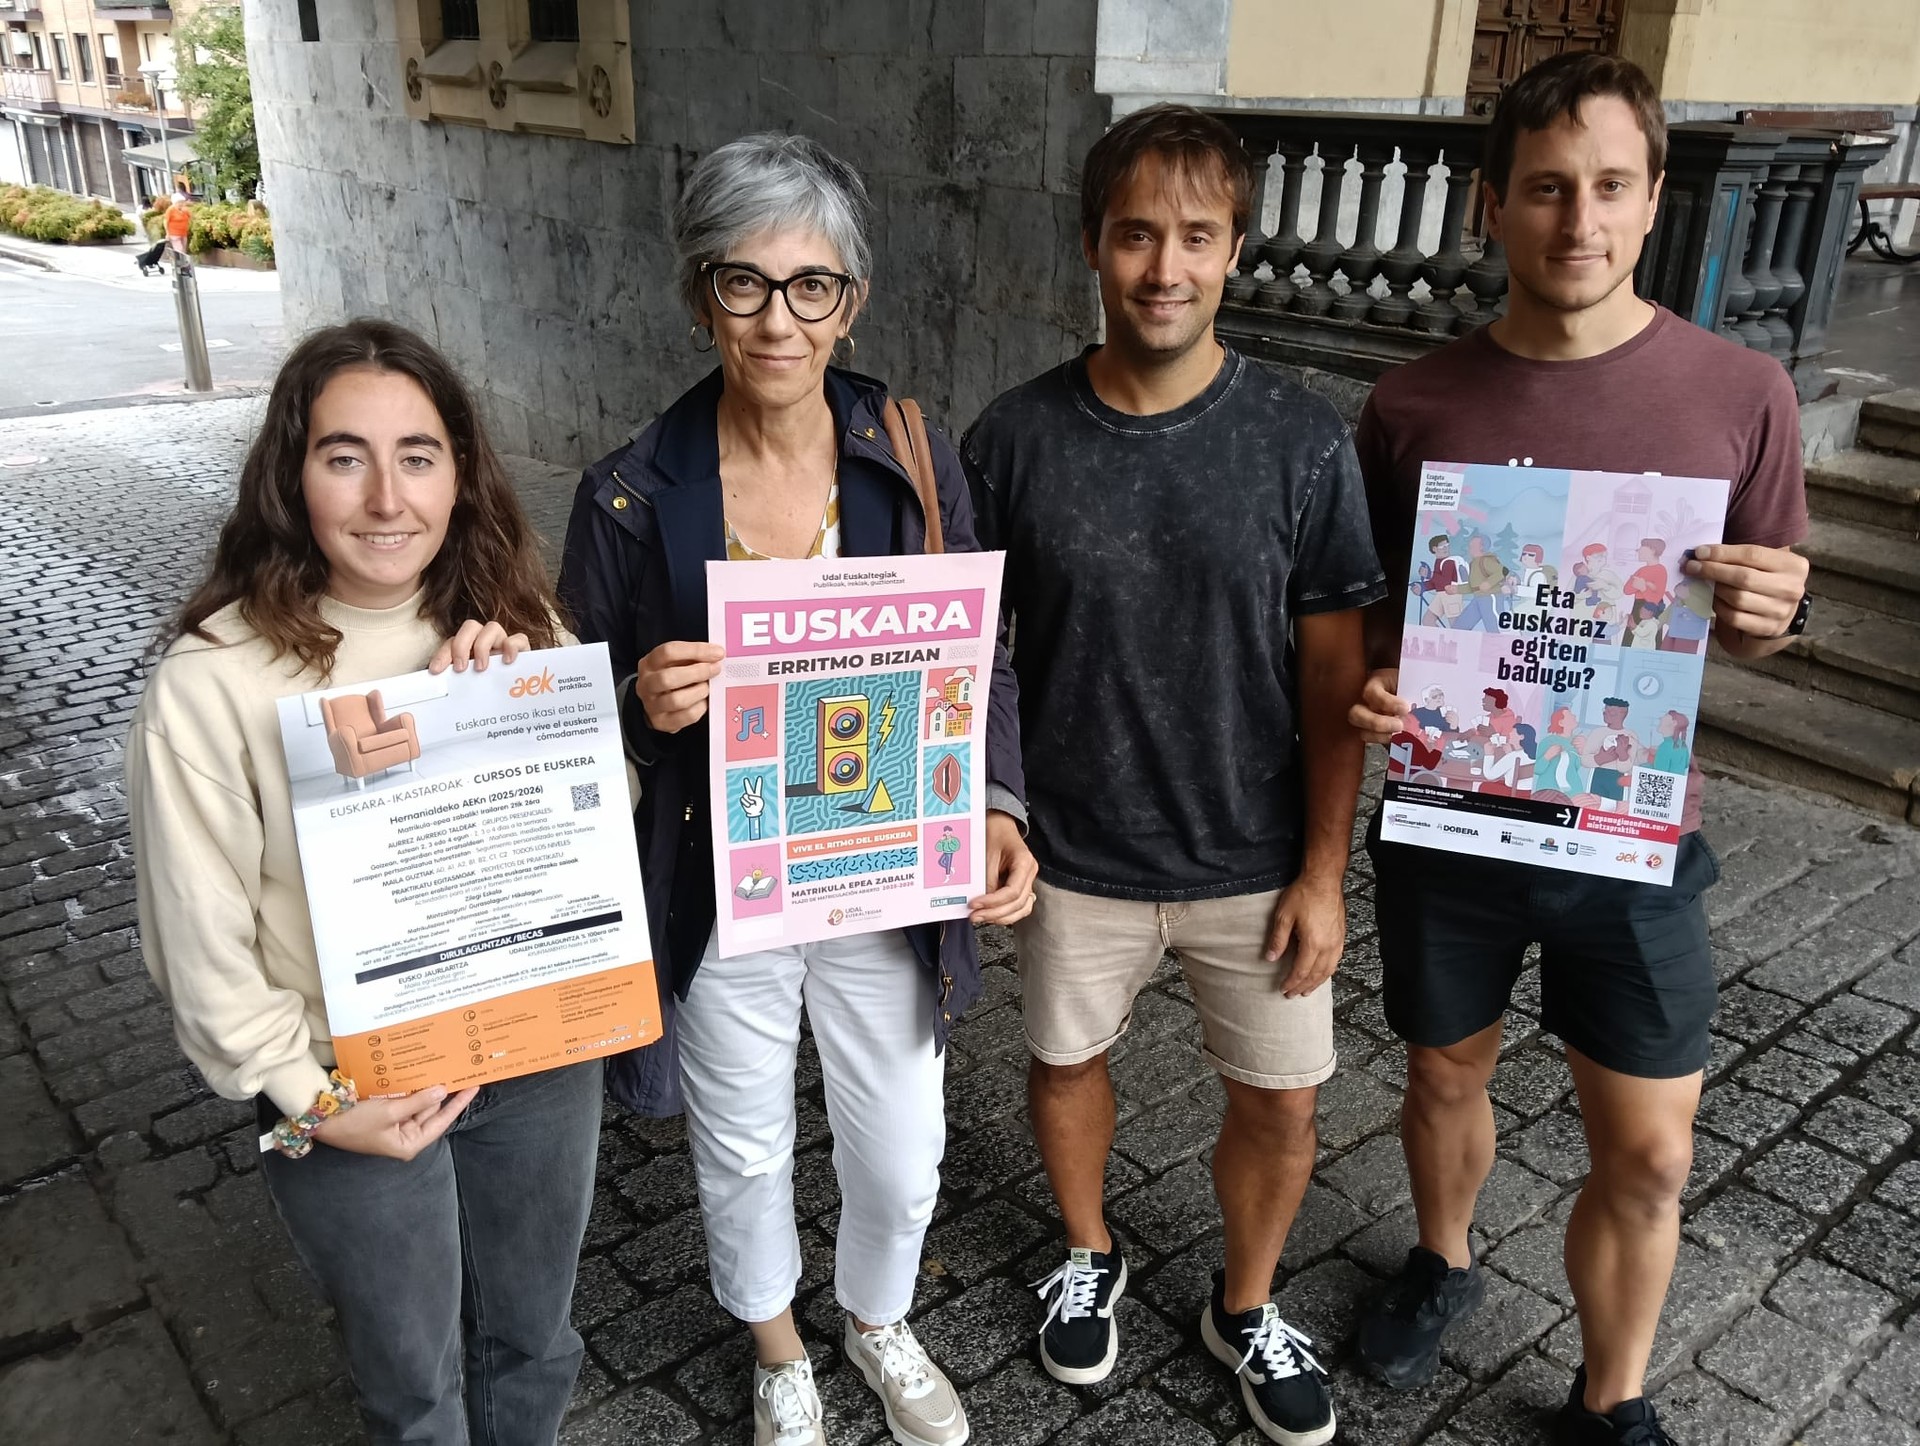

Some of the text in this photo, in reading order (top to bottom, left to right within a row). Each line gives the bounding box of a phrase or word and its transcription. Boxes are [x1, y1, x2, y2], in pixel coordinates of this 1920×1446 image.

[843, 571, 897, 580] Euskaltegiak
[1536, 583, 1576, 610] Eta
[741, 600, 972, 646] EUSKARA
[1498, 610, 1607, 640] euskaraz
[767, 648, 940, 675] ERRITMO BIZIAN
[1511, 634, 1587, 666] egiten
[508, 666, 556, 698] aek
[557, 673, 586, 685] euskara
[558, 680, 592, 692] praktikoa
[1498, 657, 1595, 693] badugu?
[455, 701, 595, 731] Euskara eroso ikasi eta bizi
[486, 725, 524, 740] Aprende
[533, 722, 551, 731] vive
[552, 720, 561, 728] el
[563, 715, 597, 727] euskera
[536, 725, 598, 741] cómodamente
[473, 767, 521, 784] CURSOS
[525, 763, 540, 774] DE
[543, 755, 595, 771] EUSKERA
[389, 784, 543, 824] Hernanialdeko AEKn (2025/2026)
[452, 810, 478, 821] zabalik!
[480, 804, 508, 814] Irailaren
[1633, 808, 1670, 820] EMAN IZENA!
[387, 837, 414, 848] AURREZ
[416, 829, 447, 841] AURREKO
[449, 822, 476, 833] TALDEAK
[481, 815, 508, 826] GRUPOS
[397, 845, 419, 855] Astean
[453, 833, 469, 842] egun
[523, 817, 547, 826] semana
[399, 851, 432, 864] eguerdian
[444, 837, 484, 852] arratsaldean
[556, 820, 575, 828] tardes
[792, 844, 813, 854] VIVE
[827, 840, 851, 849] RITMO
[854, 837, 872, 846] DEL
[874, 831, 913, 843] EUSKERA
[1444, 824, 1479, 836] DOBERA
[1586, 822, 1640, 836] mintzapraktika
[352, 872, 382, 884] Jarraipen
[383, 860, 432, 877] pertsonalizatua
[433, 850, 471, 863] tutoretzetan
[512, 832, 554, 846] personalizado
[382, 876, 403, 887] MAILA
[405, 870, 434, 881] GUZTIAK
[512, 846, 534, 855] TODOS
[547, 839, 570, 848] NIVELES
[1616, 851, 1638, 864] aek
[391, 881, 432, 896] PRAKTIKATU
[434, 870, 475, 885] EGITASMOAK
[480, 860, 516, 873] PROYECTOS
[394, 891, 429, 904] Euskararen
[430, 883, 457, 894] erabilera
[459, 875, 492, 887] sustatzeko
[504, 866, 531, 876] euskaraz
[558, 857, 578, 866] saioak
[792, 873, 915, 898] MATRIKULA EPEA ZABALIK
[426, 888, 542, 920] Mintzalagun/ Gurasolagun/ Hikalagun
[464, 888, 502, 901] Zilegi Eskola
[508, 944, 532, 954] UDALEN
[533, 934, 579, 948] DIRULAGUNTZA
[398, 961, 468, 984] EUSKO JAURLARITZA
